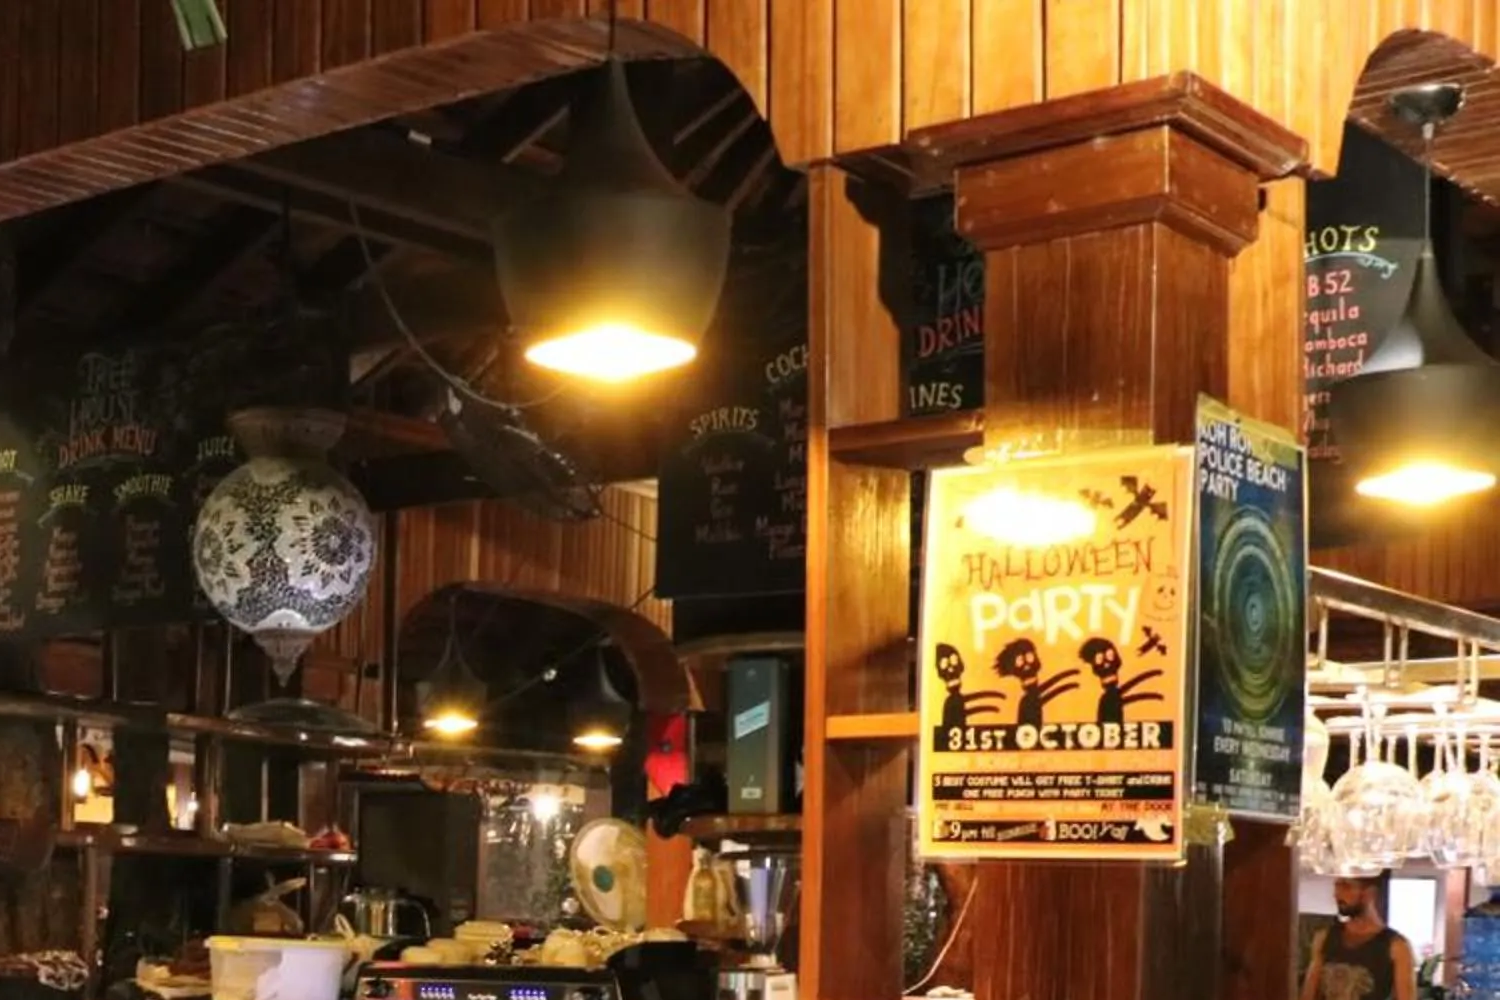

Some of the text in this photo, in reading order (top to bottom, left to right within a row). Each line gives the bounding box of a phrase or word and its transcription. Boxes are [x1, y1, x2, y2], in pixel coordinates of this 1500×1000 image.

[1303, 296, 1360, 334] quila
[690, 405, 760, 439] SPIRITS
[1200, 442, 1287, 494] POLICE BEACH
[962, 537, 1156, 591] HALLOWEEN
[1015, 723, 1161, 750] OCTOBER
